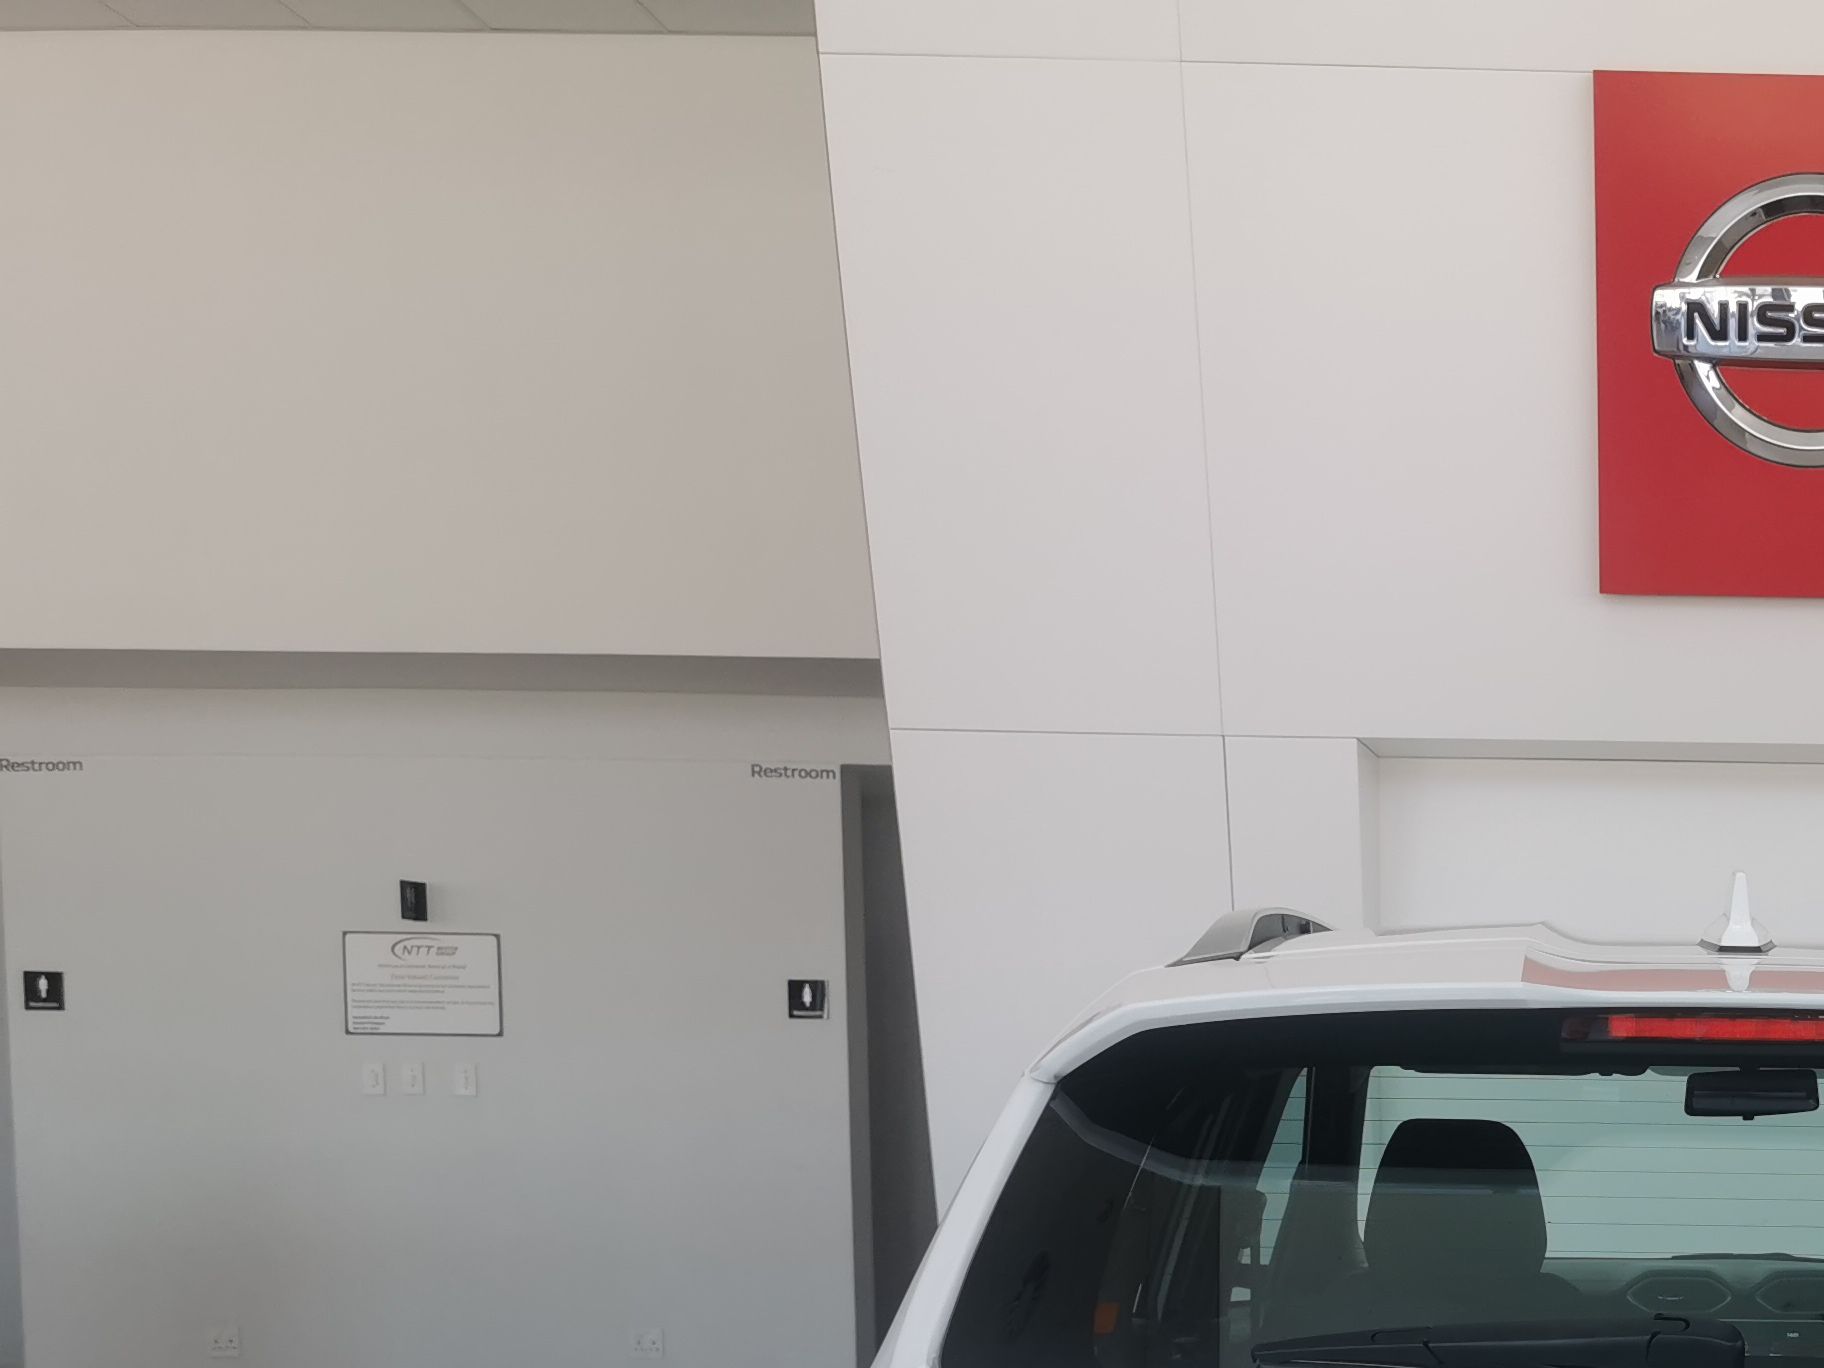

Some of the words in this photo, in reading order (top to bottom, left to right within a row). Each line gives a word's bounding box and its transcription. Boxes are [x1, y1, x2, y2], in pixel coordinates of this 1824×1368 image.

[0, 758, 83, 772] Restroom
[751, 763, 836, 780] Restroom
[402, 944, 435, 956] NTT
